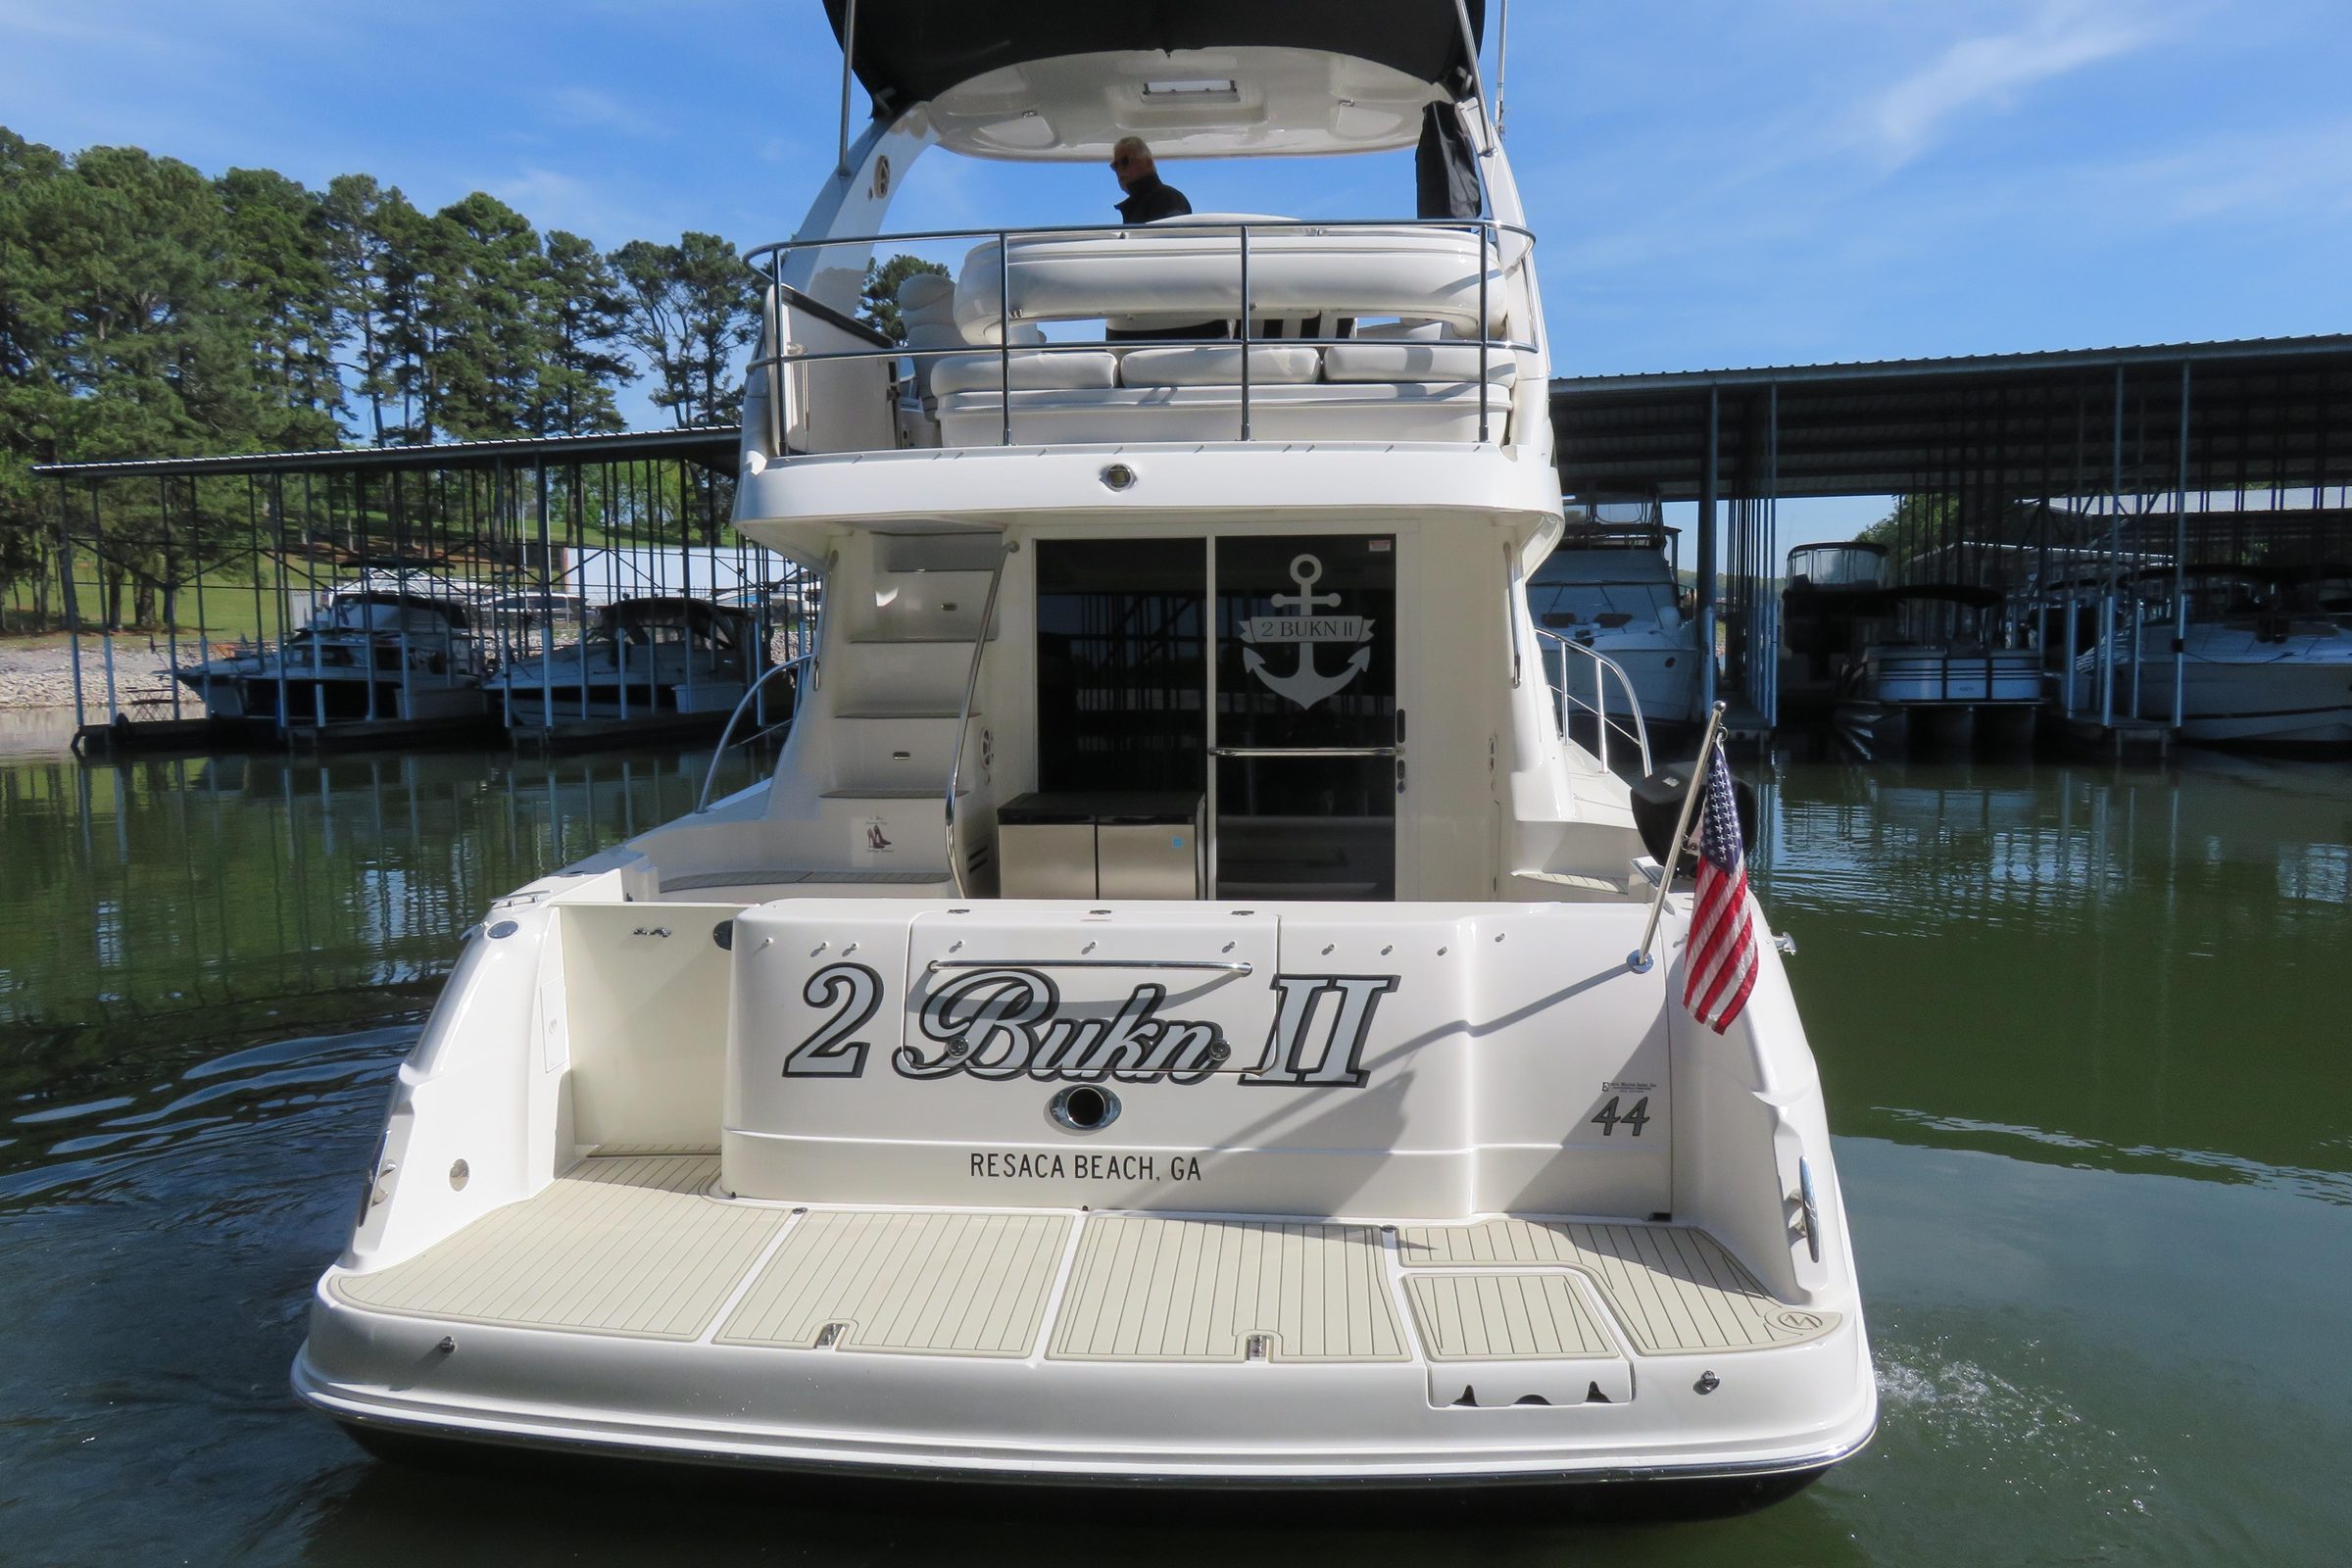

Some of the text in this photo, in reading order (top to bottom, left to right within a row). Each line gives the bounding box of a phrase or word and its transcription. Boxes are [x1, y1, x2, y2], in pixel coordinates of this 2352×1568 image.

[1261, 620, 1273, 636] 2
[1280, 619, 1337, 637] BUKN
[783, 962, 1400, 1087] 2 Bukn II
[1592, 1096, 1649, 1136] 44
[970, 1152, 1201, 1182] RESACA BEACH, GA
